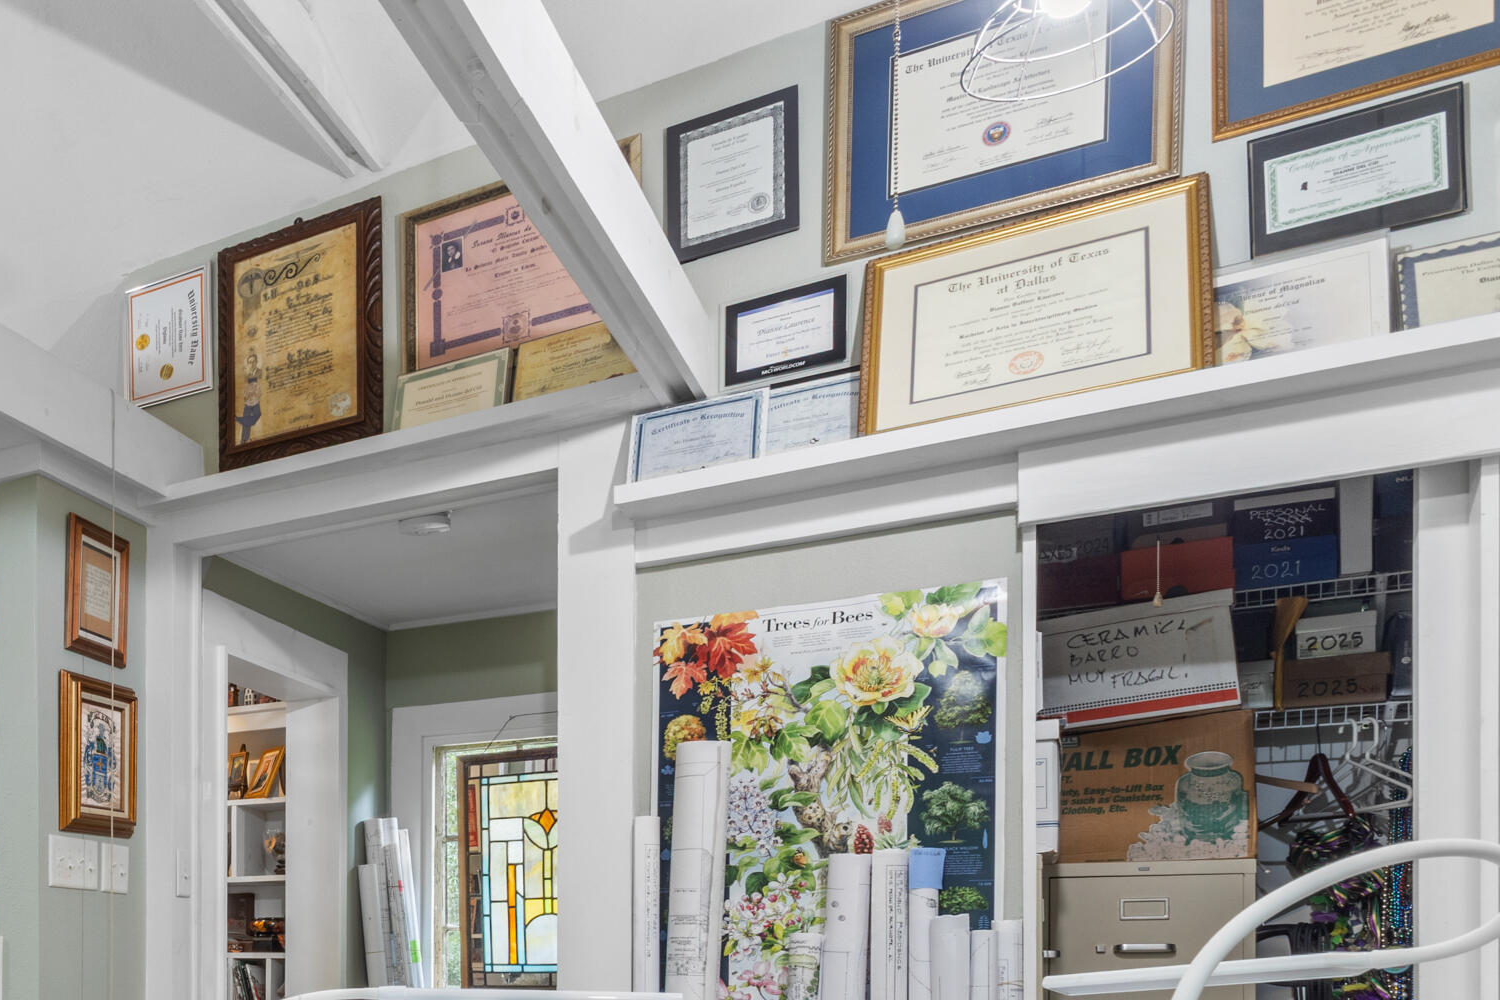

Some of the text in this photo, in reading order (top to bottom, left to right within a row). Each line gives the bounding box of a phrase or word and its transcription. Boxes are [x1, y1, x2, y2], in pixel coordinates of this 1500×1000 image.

[947, 248, 1110, 293] The University of Texas
[996, 273, 1057, 295] at Dallas
[187, 288, 199, 366] University Name
[769, 398, 801, 412] rtificate
[1250, 503, 1327, 520] PERSONAL
[1264, 525, 1305, 540] 2021
[1251, 560, 1301, 580] 2021
[762, 609, 874, 633] Trees for Bees
[1305, 631, 1365, 651] 2025
[1070, 646, 1140, 667] BARRO
[1068, 670, 1106, 686] MUY
[1298, 679, 1358, 698] 2025
[1060, 744, 1183, 772] ALL BOX
[1145, 783, 1165, 792] Box
[1061, 804, 1128, 816] Clothing, Etc.
